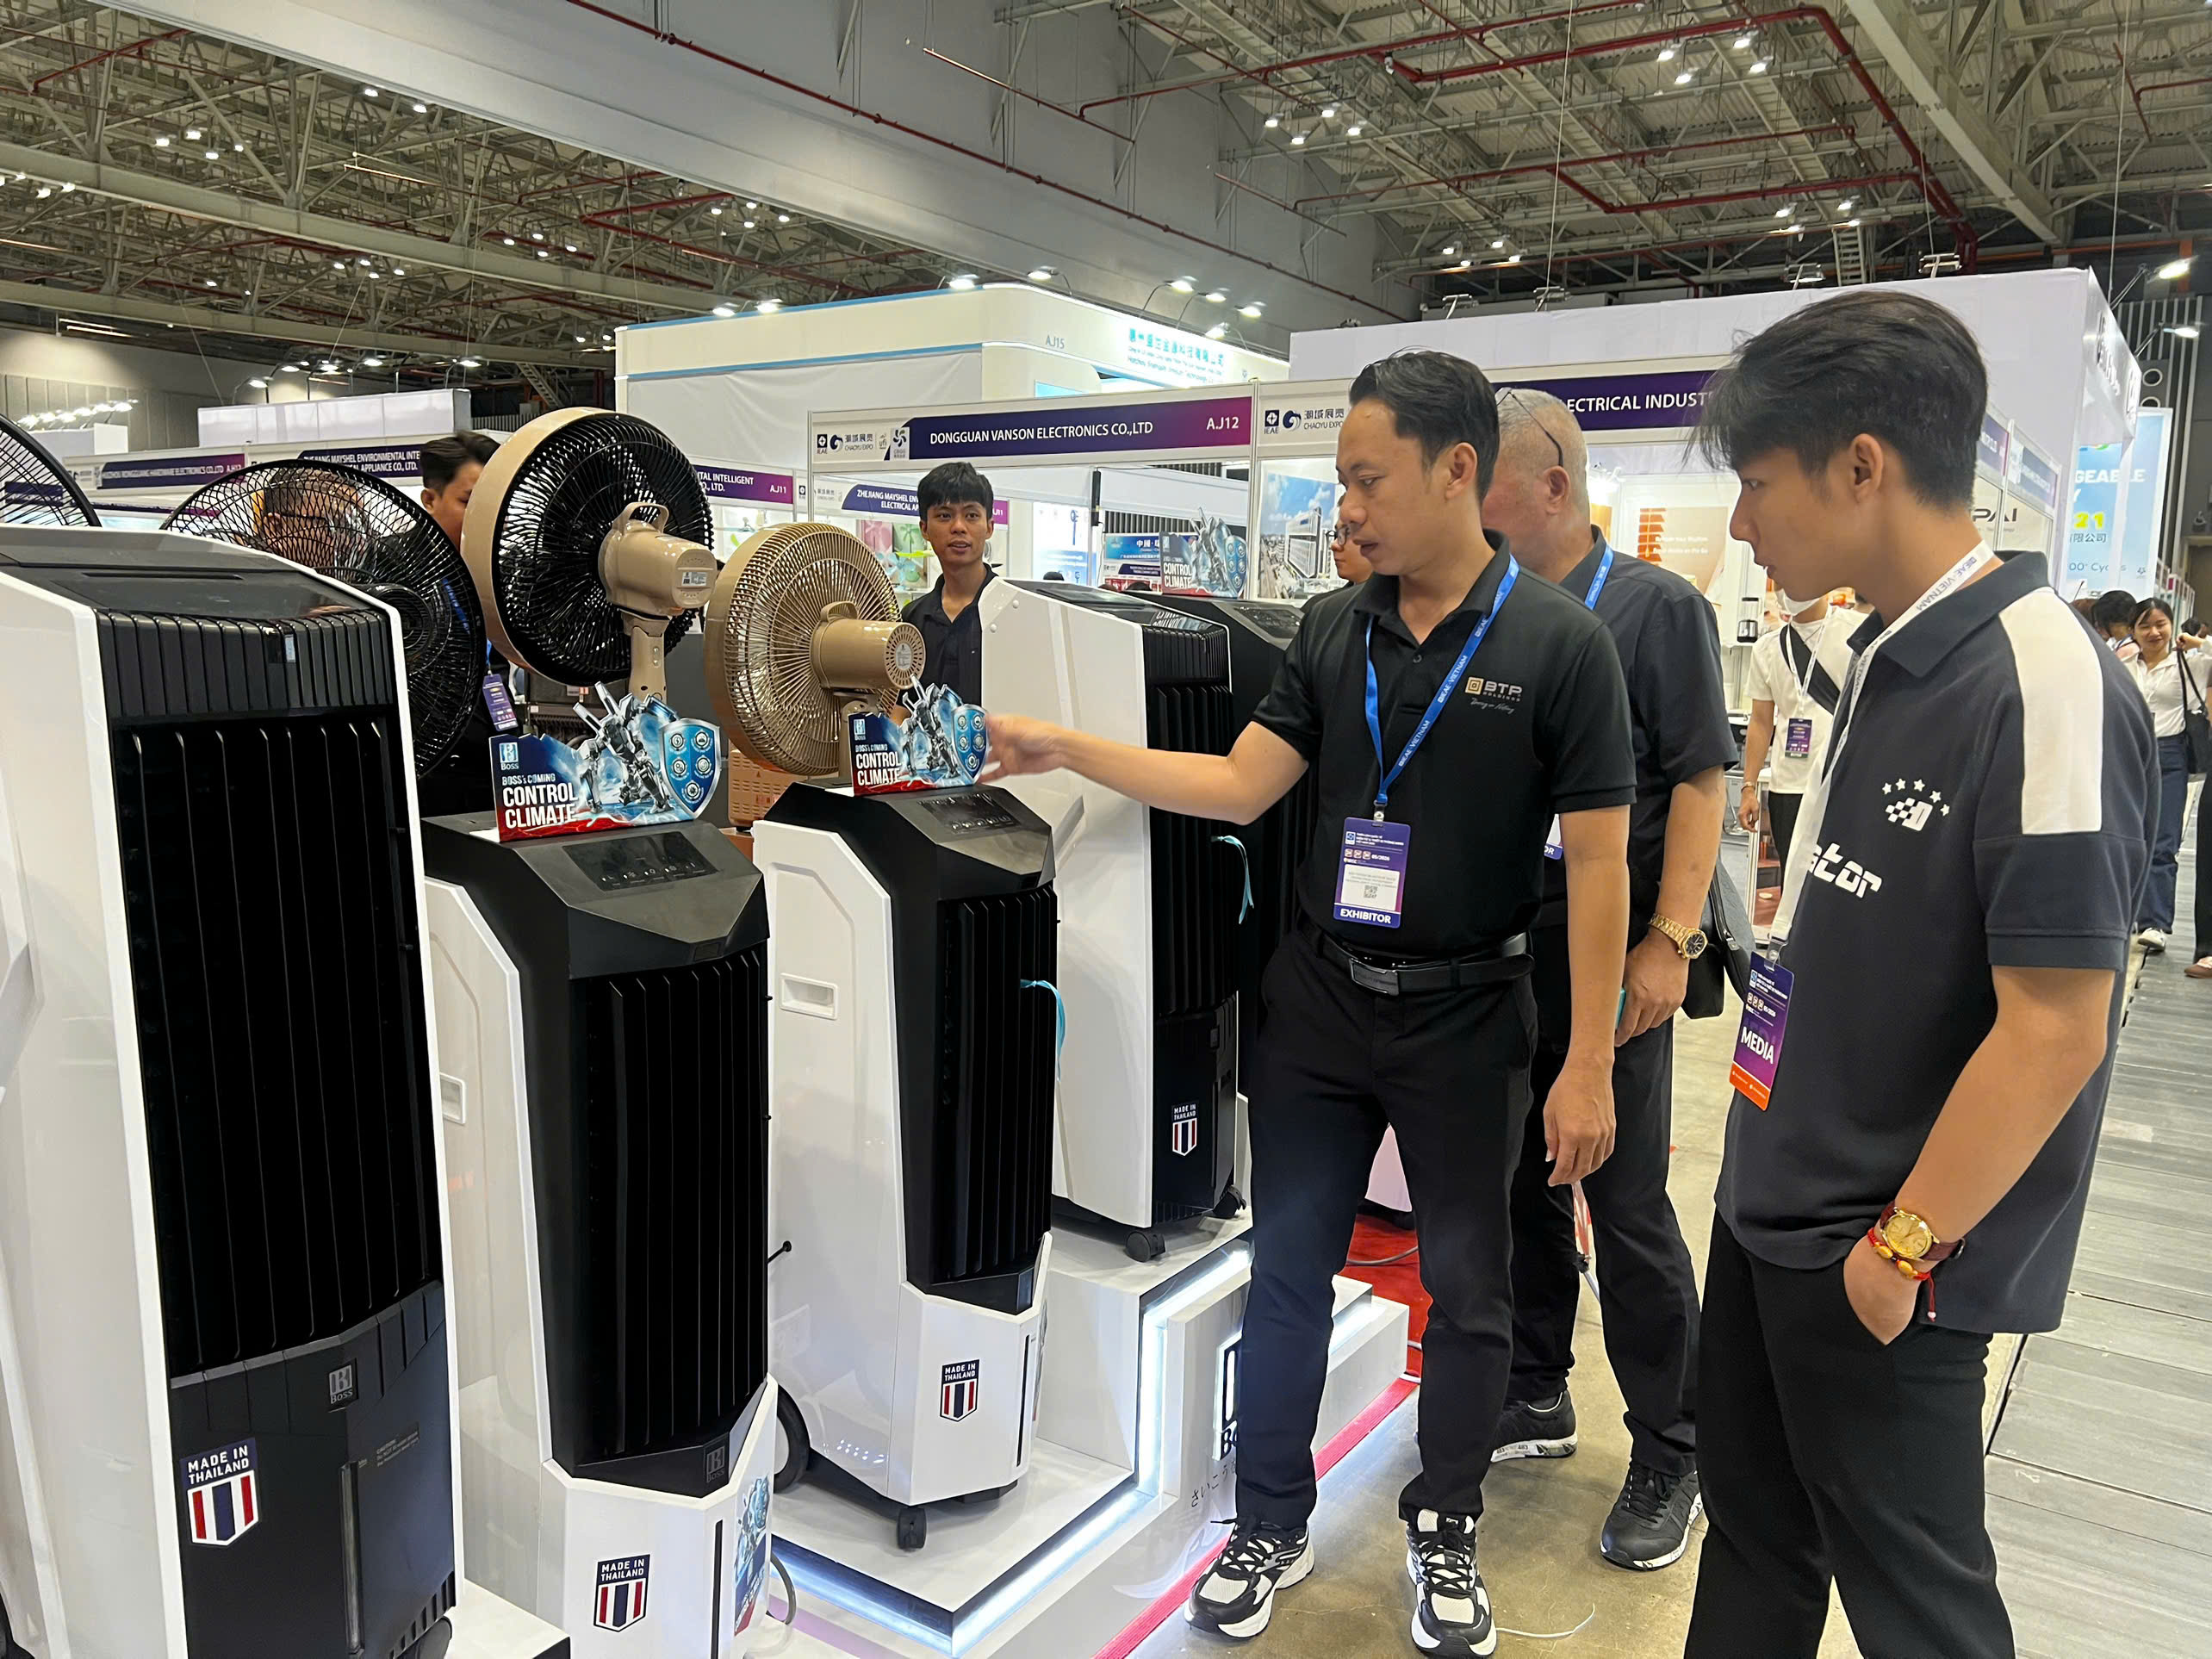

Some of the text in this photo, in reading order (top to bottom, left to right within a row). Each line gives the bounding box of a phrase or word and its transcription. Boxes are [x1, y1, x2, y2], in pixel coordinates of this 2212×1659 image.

[1566, 395, 1641, 413] ECTRICAL
[1207, 416, 1240, 430] A.J12
[930, 421, 1153, 444] DONGGUAN VANSON ELECTRONICS CO.,LTD
[357, 451, 406, 463] ENVIRONMENTAL
[361, 463, 393, 472] APPLIANCE
[713, 474, 754, 485] INTELLIGENT
[711, 483, 725, 492] LTD.
[857, 489, 884, 500] ZHEJIANG
[885, 493, 908, 502] MAYSHEL
[881, 500, 911, 511] ELECTRICAL
[2070, 532, 2107, 544] 限公司
[1163, 562, 1192, 575] CONTROL
[1164, 576, 1192, 588] CLIMATE
[1917, 577, 1955, 611] VIETNAM
[1449, 656, 1468, 683] VIETNAM
[1484, 680, 1522, 695] BTP
[1410, 720, 1430, 749] VIETNAM
[856, 751, 902, 769] CONTROL
[527, 774, 556, 784] COMING
[857, 767, 900, 786] CLIMATE
[503, 782, 578, 807] CONTROL
[505, 804, 577, 829] CLIMATE
[1340, 908, 1391, 924] EXHIBITOR
[1741, 1025, 1774, 1065] MEDIA
[1174, 1105, 1189, 1115] MADE
[1174, 1110, 1196, 1121] THAILAND
[945, 1364, 966, 1374] MADE
[945, 1370, 975, 1381] THAILAND
[188, 1445, 248, 1473] MADE IN
[189, 1457, 249, 1484] THAILAND
[602, 1559, 644, 1573] MADE IN
[601, 1568, 644, 1581] THAILAND
